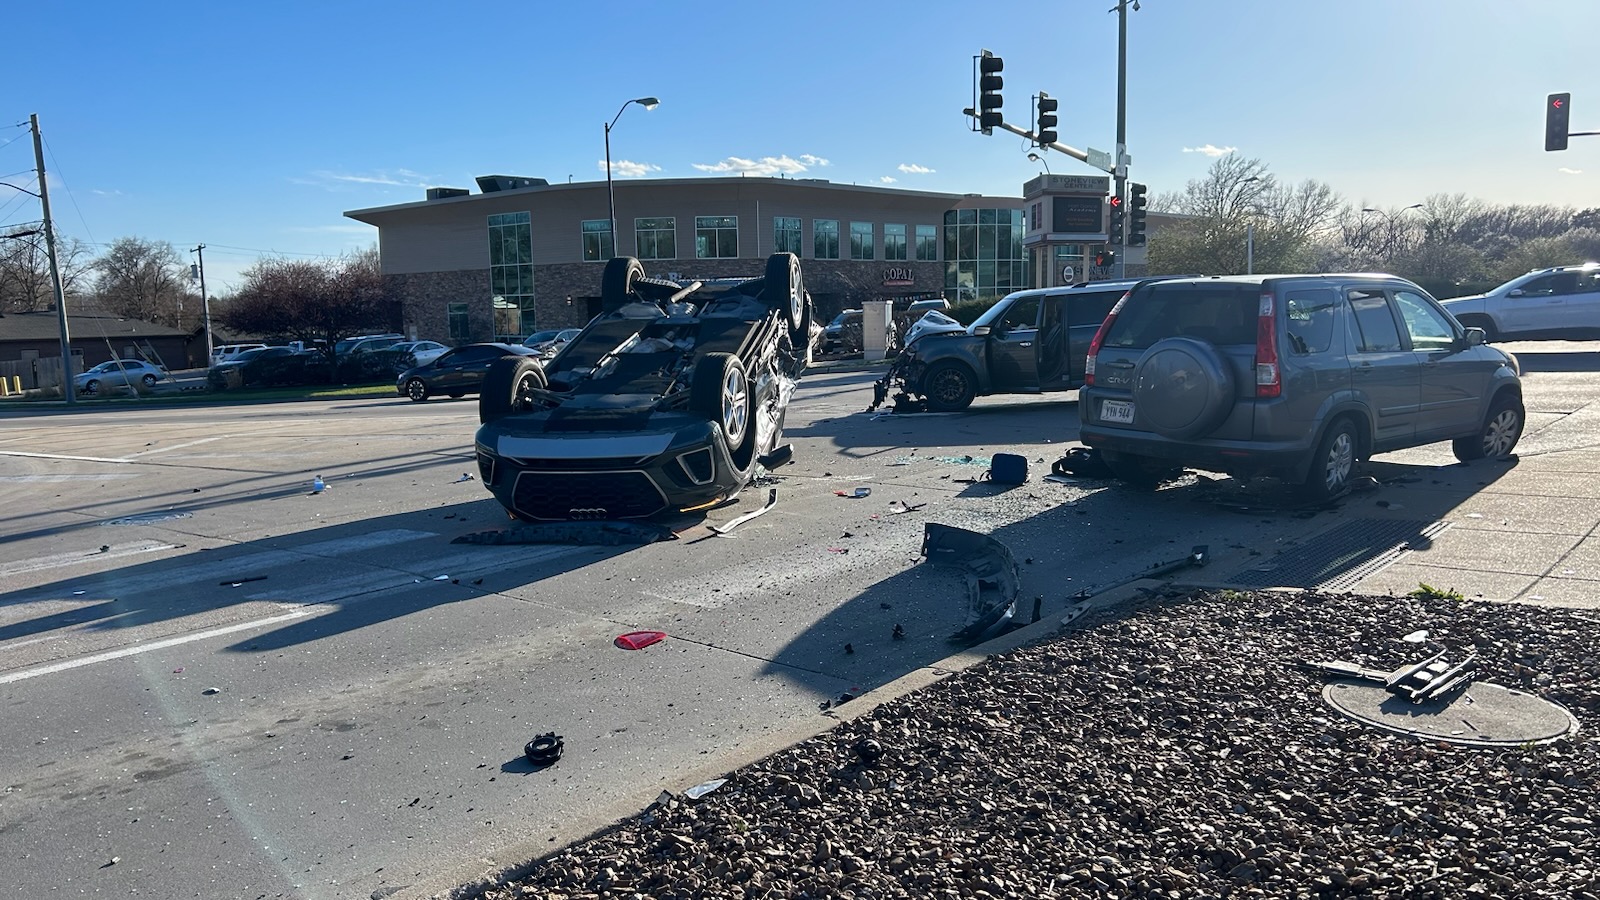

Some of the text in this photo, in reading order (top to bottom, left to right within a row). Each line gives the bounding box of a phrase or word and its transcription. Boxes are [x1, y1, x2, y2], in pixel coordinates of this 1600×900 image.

[1052, 176, 1105, 185] STONEVIEW
[883, 267, 915, 281] COPAL
[1118, 407, 1130, 419] 944
